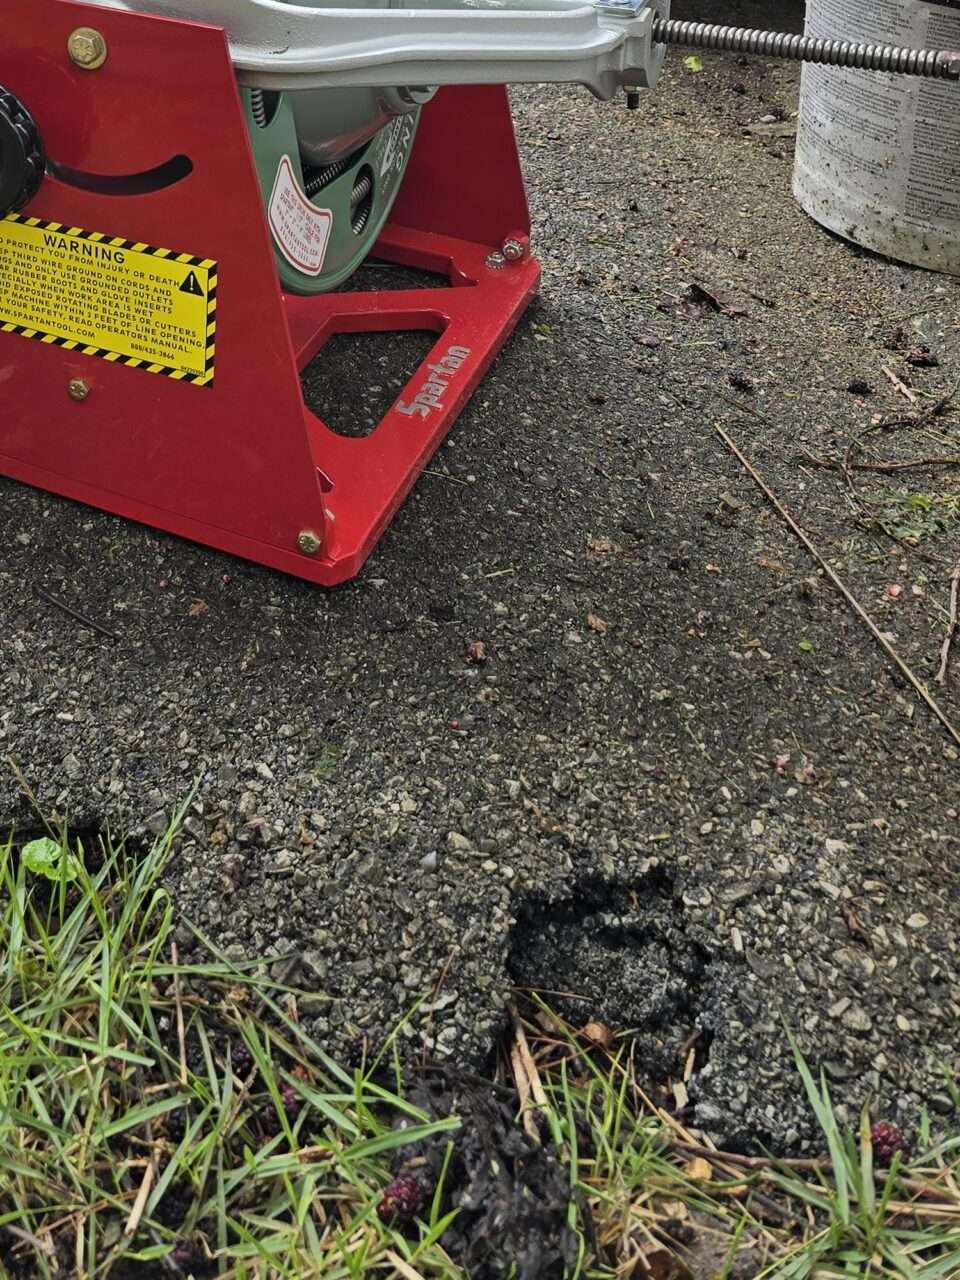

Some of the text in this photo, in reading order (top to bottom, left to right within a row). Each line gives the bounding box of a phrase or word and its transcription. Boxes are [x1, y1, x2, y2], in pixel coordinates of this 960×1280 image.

[7, 238, 44, 254] PROTECT
[48, 248, 66, 259] YOU
[69, 254, 94, 265] FROM
[97, 261, 130, 274] INJURY
[134, 270, 144, 278] OR
[149, 274, 179, 287] DEATH
[43, 233, 125, 264] WARNING
[12, 251, 38, 262] THIRD
[41, 258, 63, 269] WIRE
[66, 264, 102, 279] GROUND
[106, 274, 118, 282] ON
[121, 278, 149, 291] CORDS
[153, 287, 172, 297] AND
[13, 266, 47, 281] RUBBER
[50, 276, 77, 289] BOOTS
[80, 285, 98, 295] AND
[101, 291, 129, 302] GLOVE
[134, 299, 172, 314] INSERTS
[15, 260, 32, 270] AND
[35, 264, 57, 275] ONLY
[61, 272, 76, 280] USE
[80, 276, 129, 294] GROUNDED
[133, 290, 174, 306] OUTLETS
[6, 298, 28, 309] YOUR
[69, 315, 93, 326] READ
[96, 322, 148, 342] OPERATORS
[12, 291, 49, 306] MACHINE
[53, 303, 84, 316] WITHIN
[94, 313, 117, 324] FEET
[121, 320, 131, 328] OF
[136, 326, 157, 336] LINE
[14, 284, 53, 300] EXPOSED
[56, 295, 98, 311] ROTATING
[102, 307, 136, 321] BLADES
[155, 320, 196, 337] CUTTERS
[41, 282, 65, 294] WHEN
[69, 290, 92, 301] WORK
[96, 298, 120, 308] AREA
[135, 308, 153, 318] WET
[394, 345, 472, 417] Spartan
